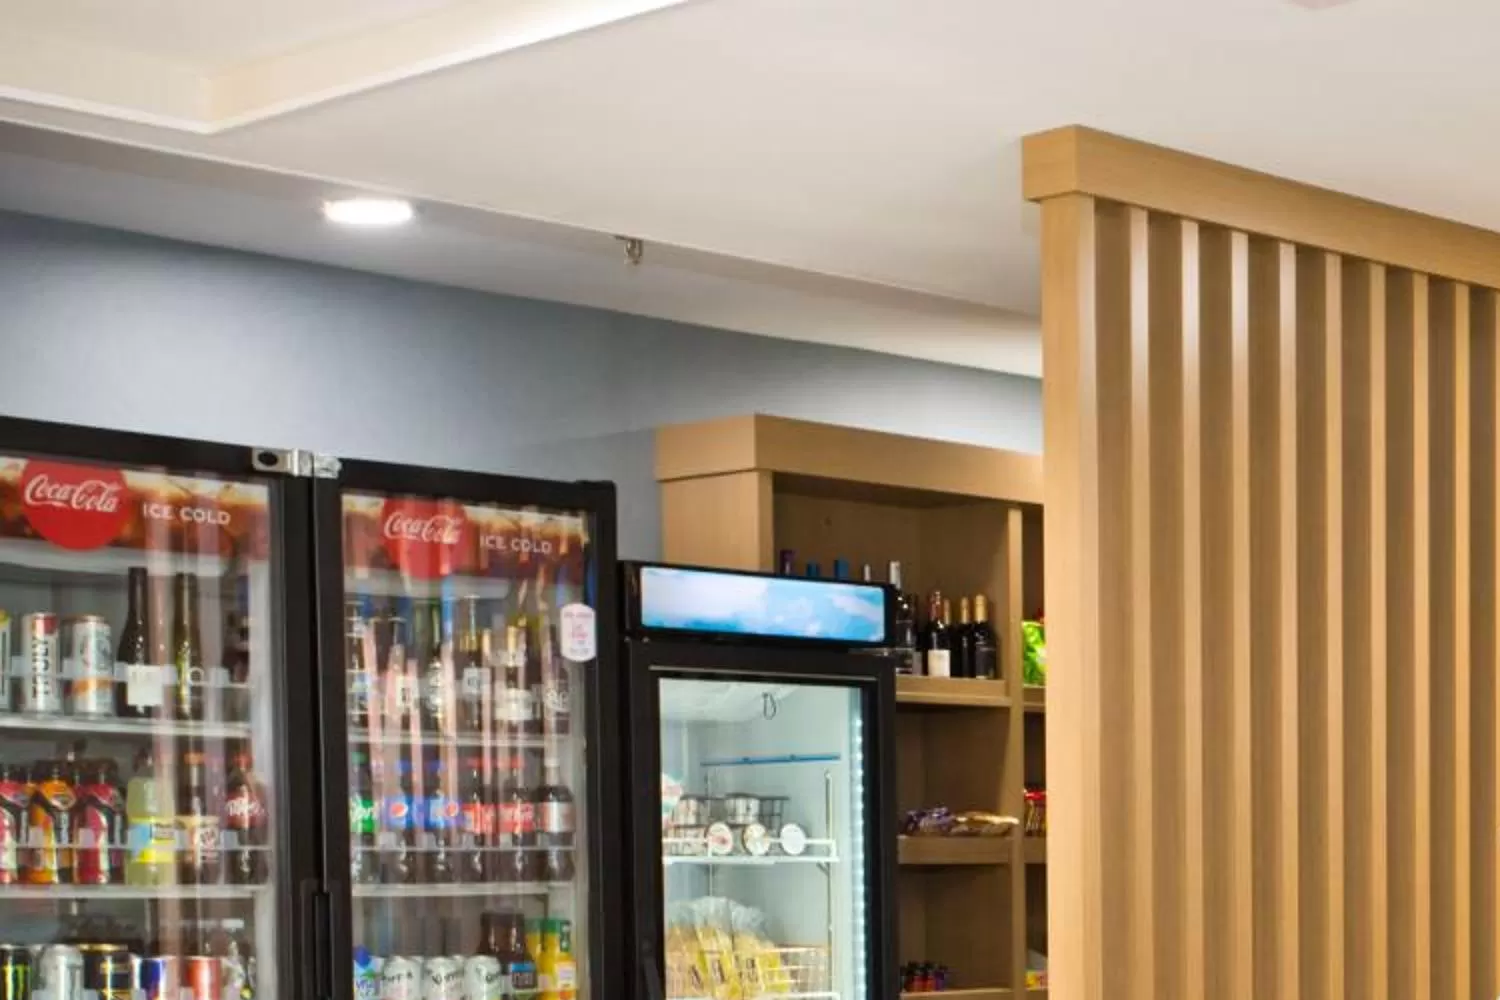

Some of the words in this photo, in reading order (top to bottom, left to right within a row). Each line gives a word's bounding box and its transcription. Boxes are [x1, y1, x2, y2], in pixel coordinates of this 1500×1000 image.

[142, 501, 173, 520] ICE
[179, 506, 231, 526] COLD
[479, 534, 505, 549] ICE
[510, 537, 552, 553] COLD
